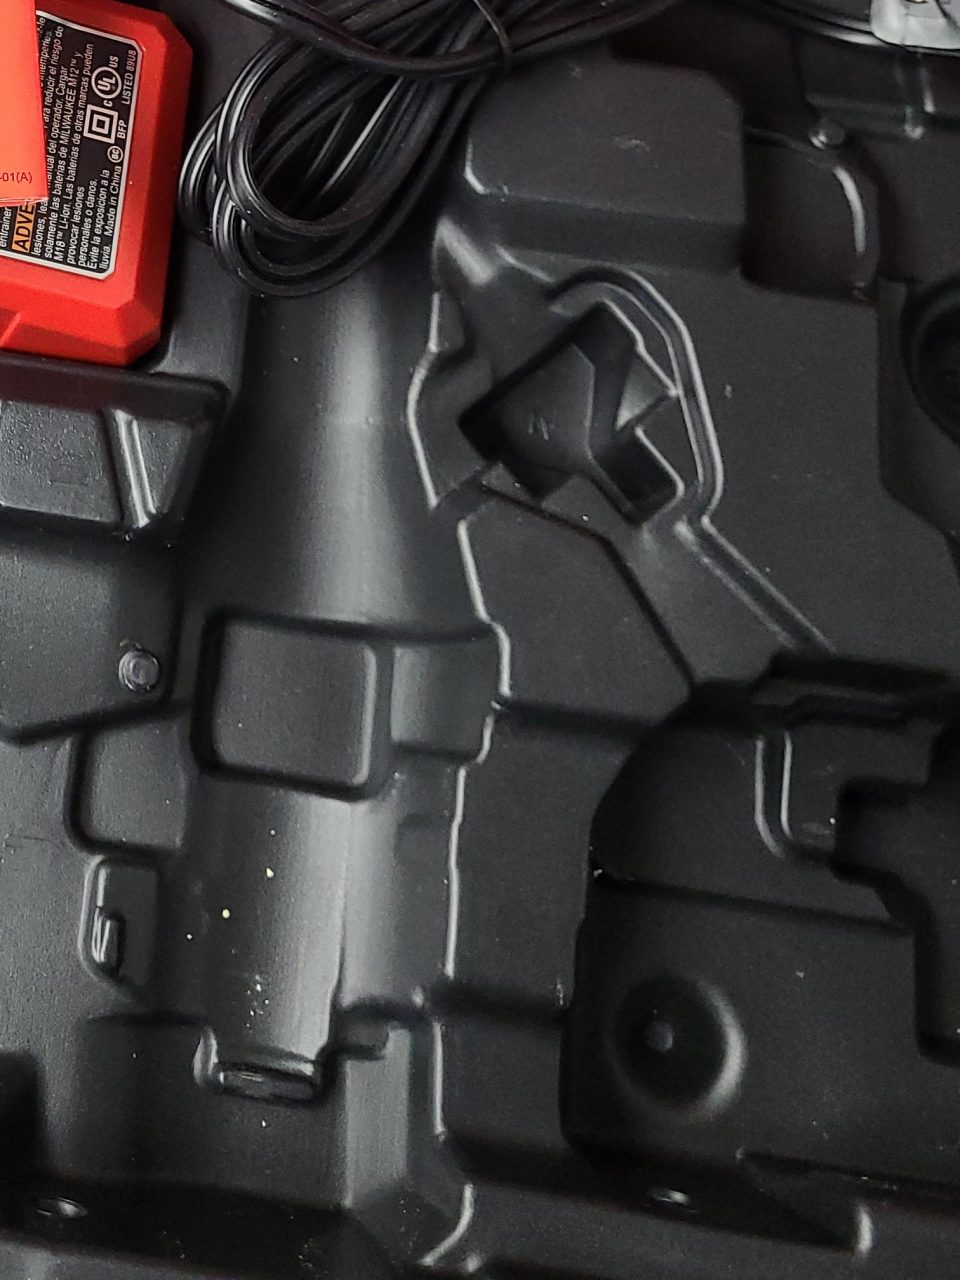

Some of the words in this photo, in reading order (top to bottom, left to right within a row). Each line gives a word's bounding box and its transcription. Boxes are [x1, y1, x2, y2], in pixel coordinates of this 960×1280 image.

[48, 65, 57, 75] el
[82, 43, 93, 76] pueden
[109, 55, 118, 68] US
[44, 76, 55, 106] reducir
[78, 76, 89, 108] marcas
[121, 72, 133, 104] LISTED
[59, 88, 76, 145] MILWAUKEE
[74, 109, 84, 131] otras
[116, 119, 127, 139] BFP
[57, 146, 68, 158] de
[71, 133, 81, 144] de
[30, 217, 47, 256] lesiones,
[47, 139, 57, 153] del
[55, 66, 69, 95] Cargar
[100, 169, 110, 178] la
[62, 183, 74, 199] Las
[109, 165, 121, 194] China
[49, 196, 60, 210] las
[70, 186, 85, 223] lesiones
[94, 187, 107, 234] exposicion
[108, 196, 117, 205] in
[44, 212, 58, 258] solamente
[103, 207, 115, 236] Made
[67, 224, 79, 264] provocar
[78, 217, 92, 267] personales
[90, 236, 101, 245] la
[86, 246, 99, 269] Evite
